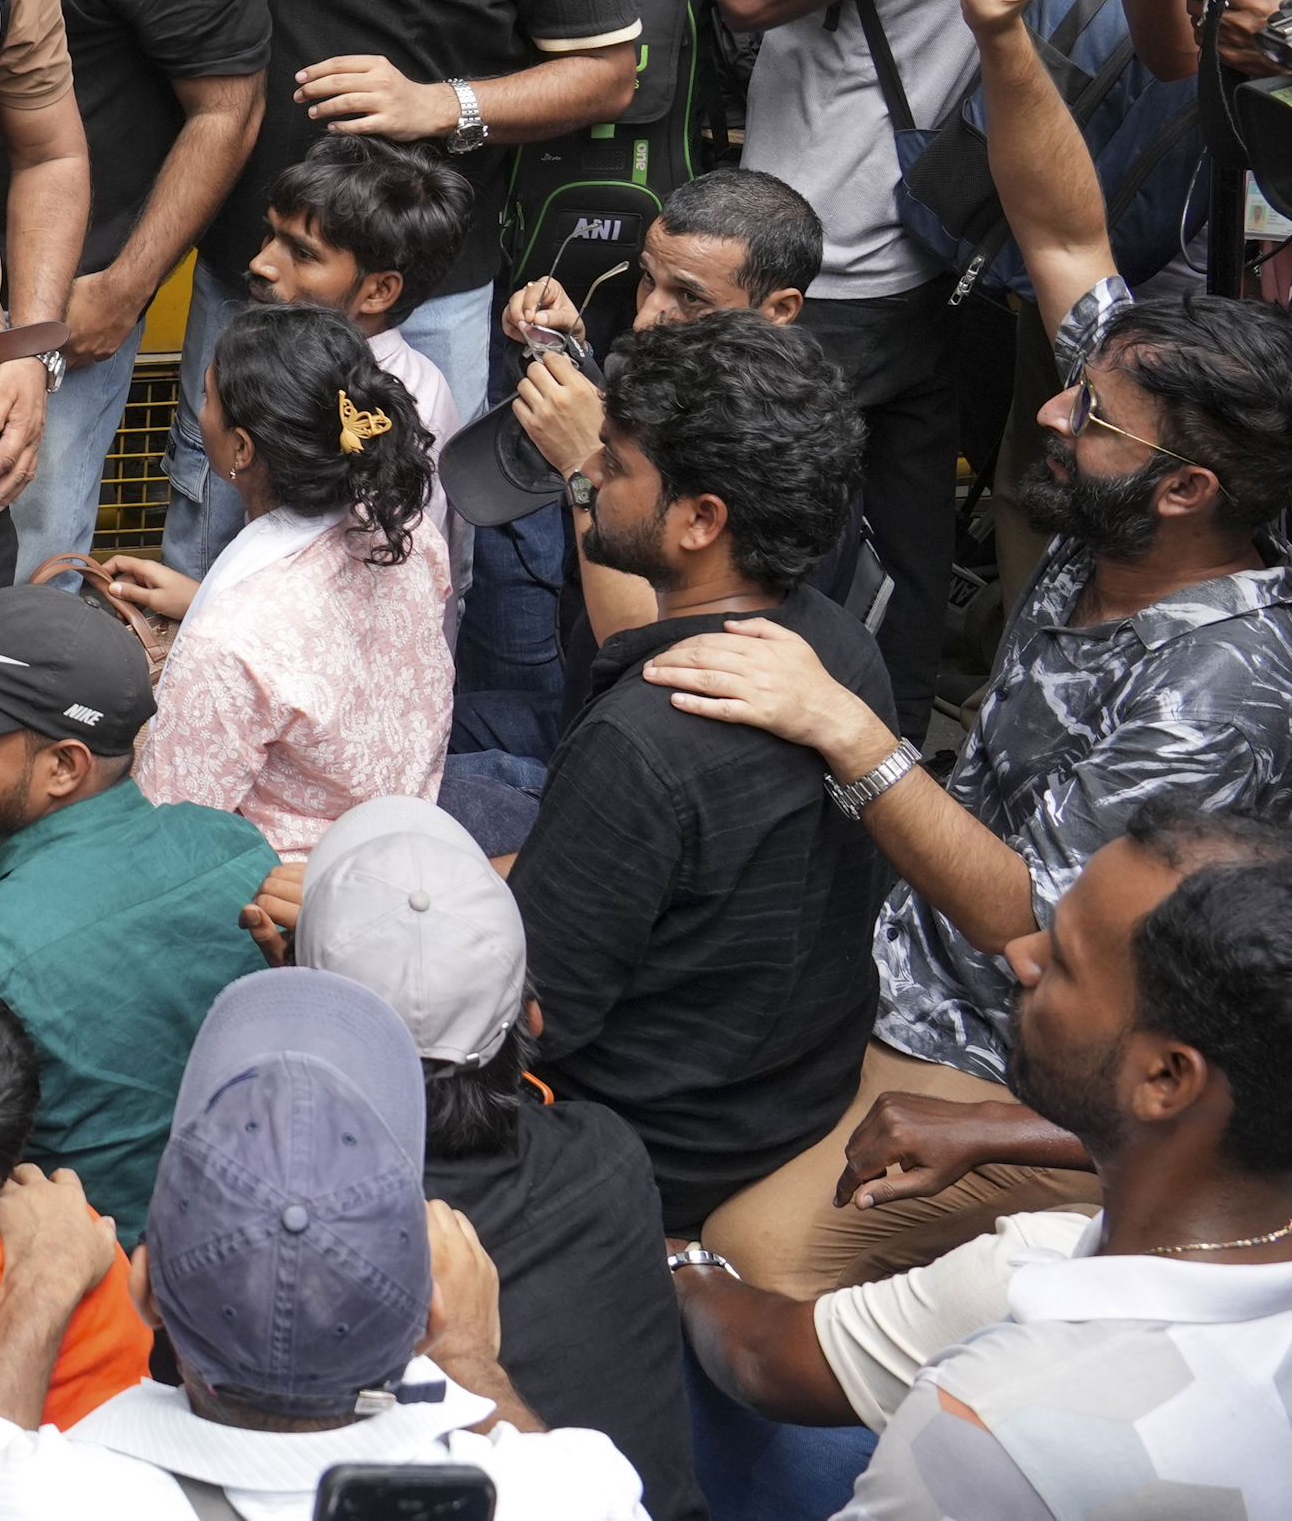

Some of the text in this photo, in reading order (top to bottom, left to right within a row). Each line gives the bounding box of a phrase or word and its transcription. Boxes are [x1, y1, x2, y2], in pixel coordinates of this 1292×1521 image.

[635, 143, 648, 171] one
[573, 217, 622, 241] ANI
[63, 703, 104, 726] NIKE
